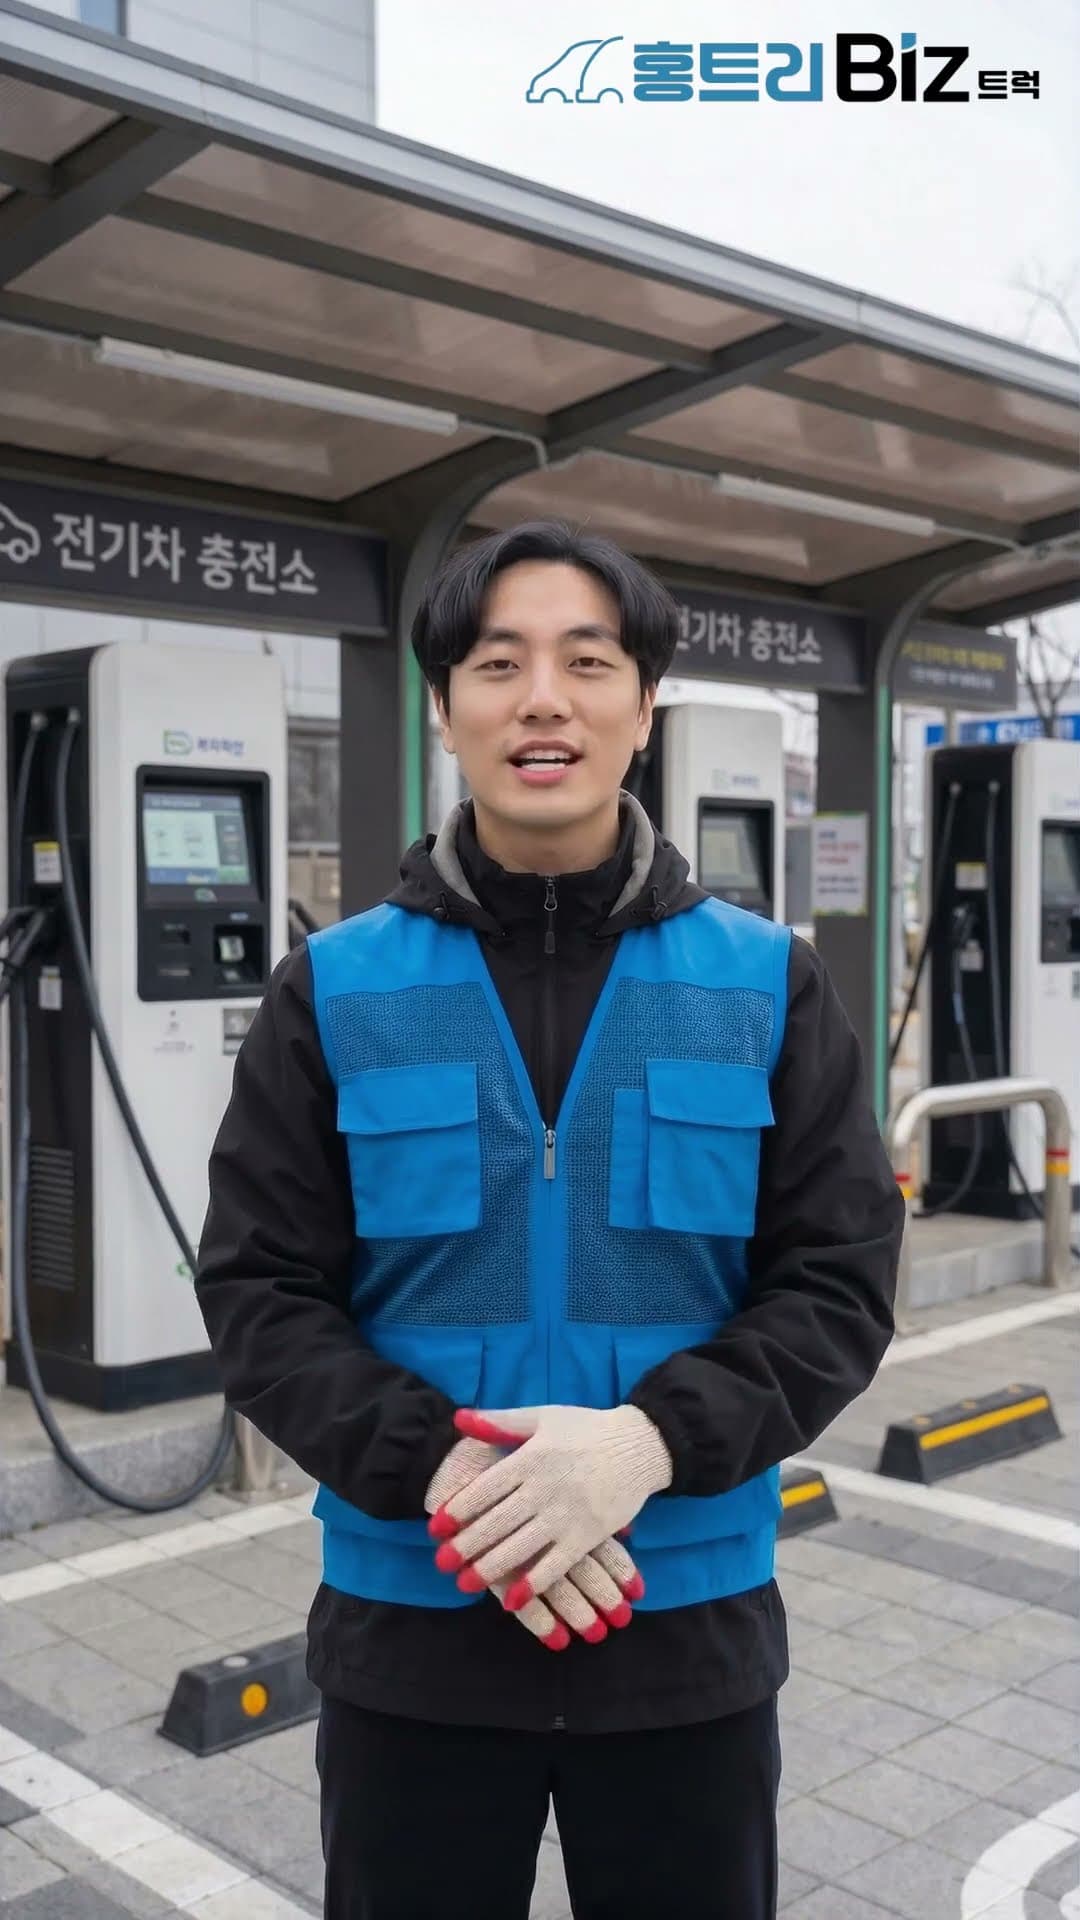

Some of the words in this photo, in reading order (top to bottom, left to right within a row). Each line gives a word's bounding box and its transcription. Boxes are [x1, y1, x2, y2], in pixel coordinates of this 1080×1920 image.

[52, 513, 186, 583] 전기차
[197, 532, 319, 595] 충전소
[749, 616, 822, 664] 충전소
